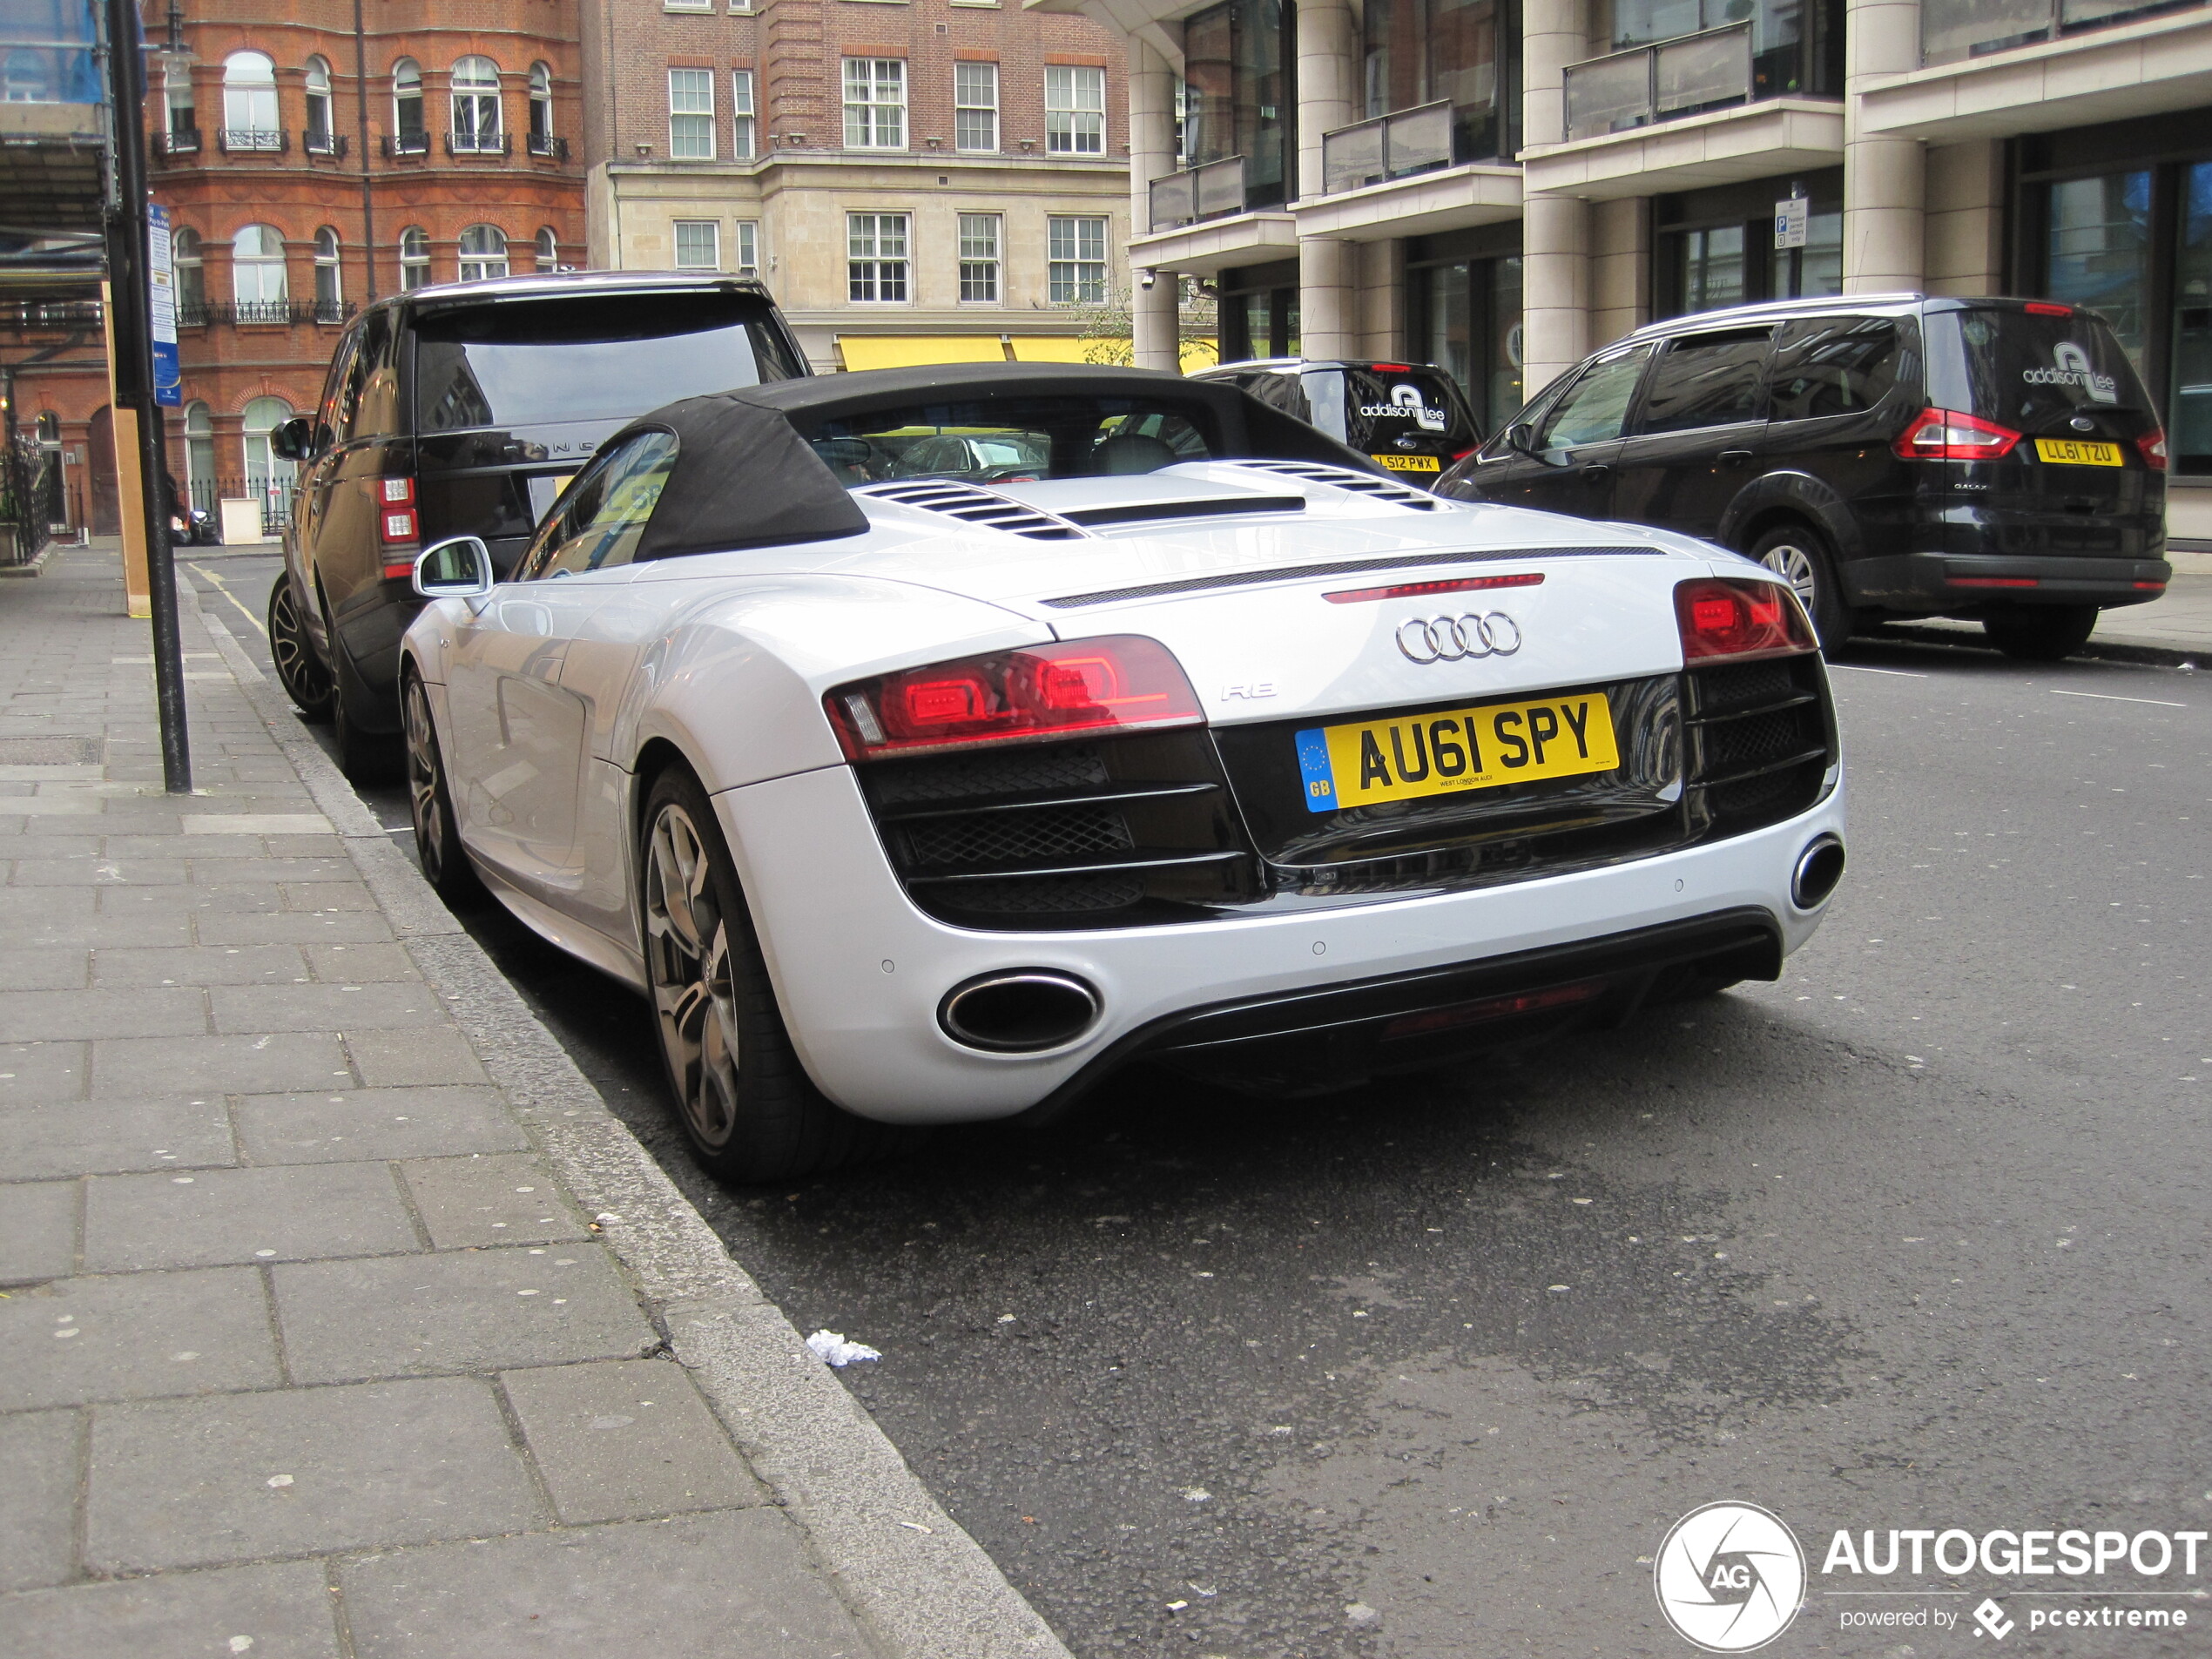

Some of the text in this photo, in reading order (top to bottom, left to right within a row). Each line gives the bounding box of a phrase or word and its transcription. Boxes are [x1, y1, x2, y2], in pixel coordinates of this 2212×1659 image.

[2023, 368, 2114, 389] addison lee
[1360, 403, 1445, 421] addison lee
[503, 440, 607, 453] RANG
[2045, 442, 2112, 462] LL61 TZU
[1379, 457, 1433, 469] LS12 PWX
[1221, 682, 1278, 702] R8
[1360, 702, 1588, 790] AU61 SPY
[1309, 779, 1332, 798] GB
[1456, 776, 1480, 785] LONDON
